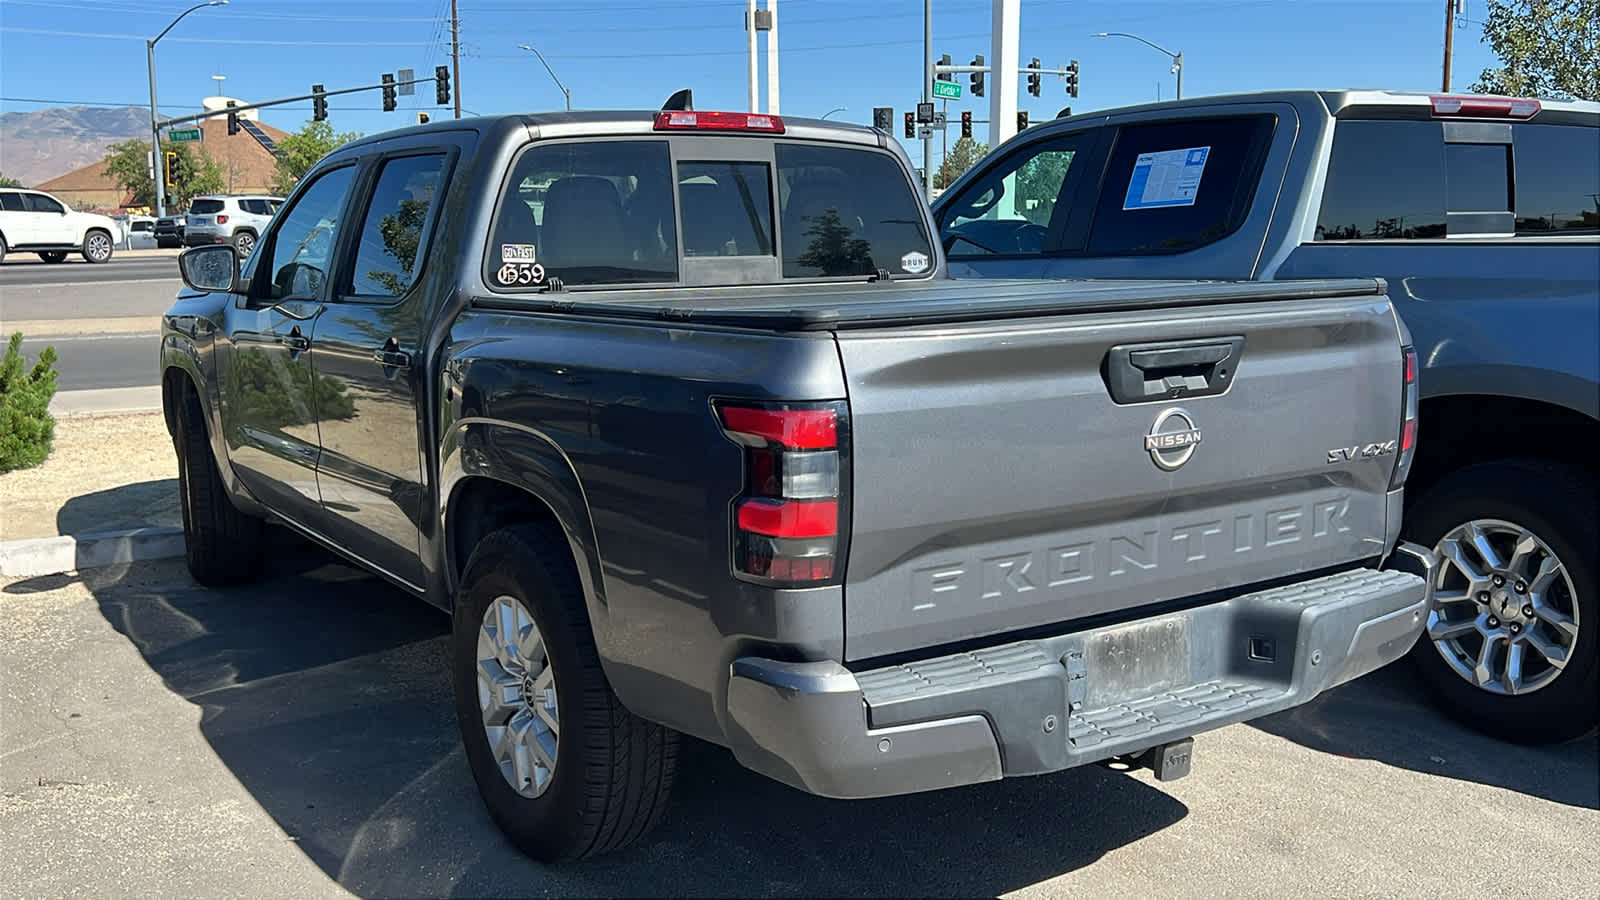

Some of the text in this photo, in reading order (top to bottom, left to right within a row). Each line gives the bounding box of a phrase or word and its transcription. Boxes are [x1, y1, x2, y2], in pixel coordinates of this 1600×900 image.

[497, 263, 545, 285] G59
[1148, 431, 1202, 448] NISSAN
[1326, 446, 1359, 464] SV
[911, 494, 1352, 611] FRONTIER
